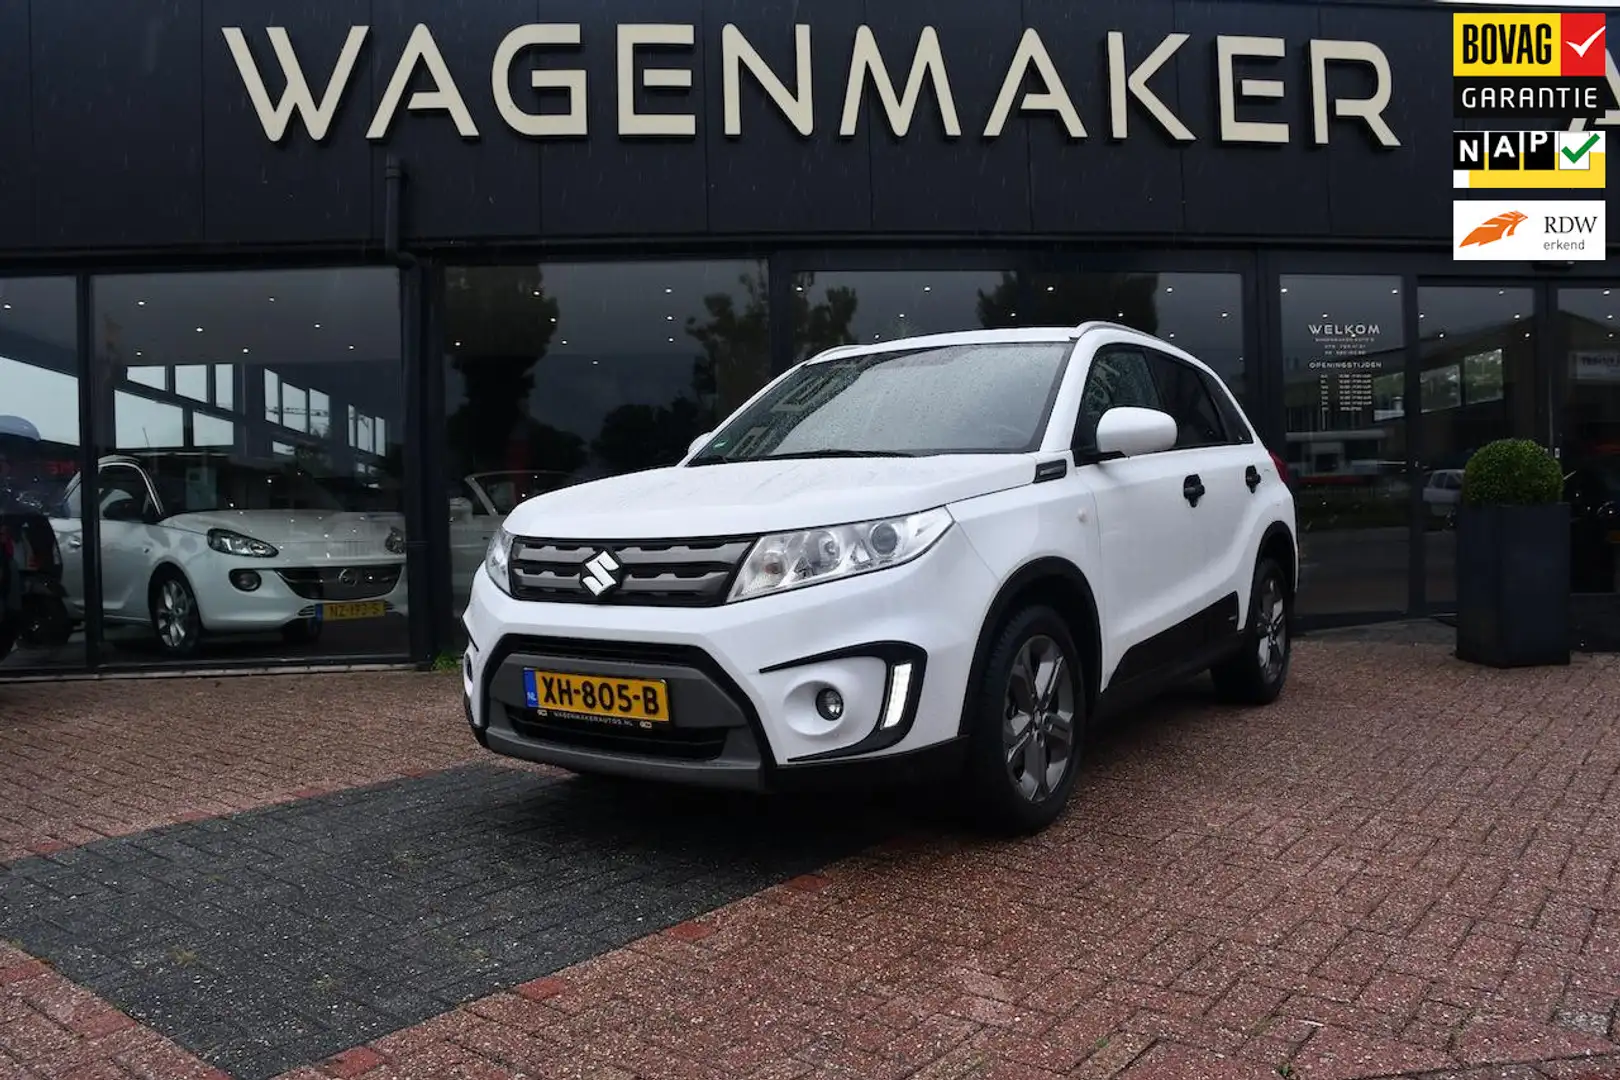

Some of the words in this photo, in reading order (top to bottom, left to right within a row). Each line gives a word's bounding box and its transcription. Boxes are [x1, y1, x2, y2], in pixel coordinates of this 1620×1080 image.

[222, 23, 1401, 146] WAGENMAKER
[1308, 324, 1380, 335] WELKOM
[1308, 361, 1382, 369] OPENINGSTIJDEN
[541, 675, 660, 715] XH-805-B
